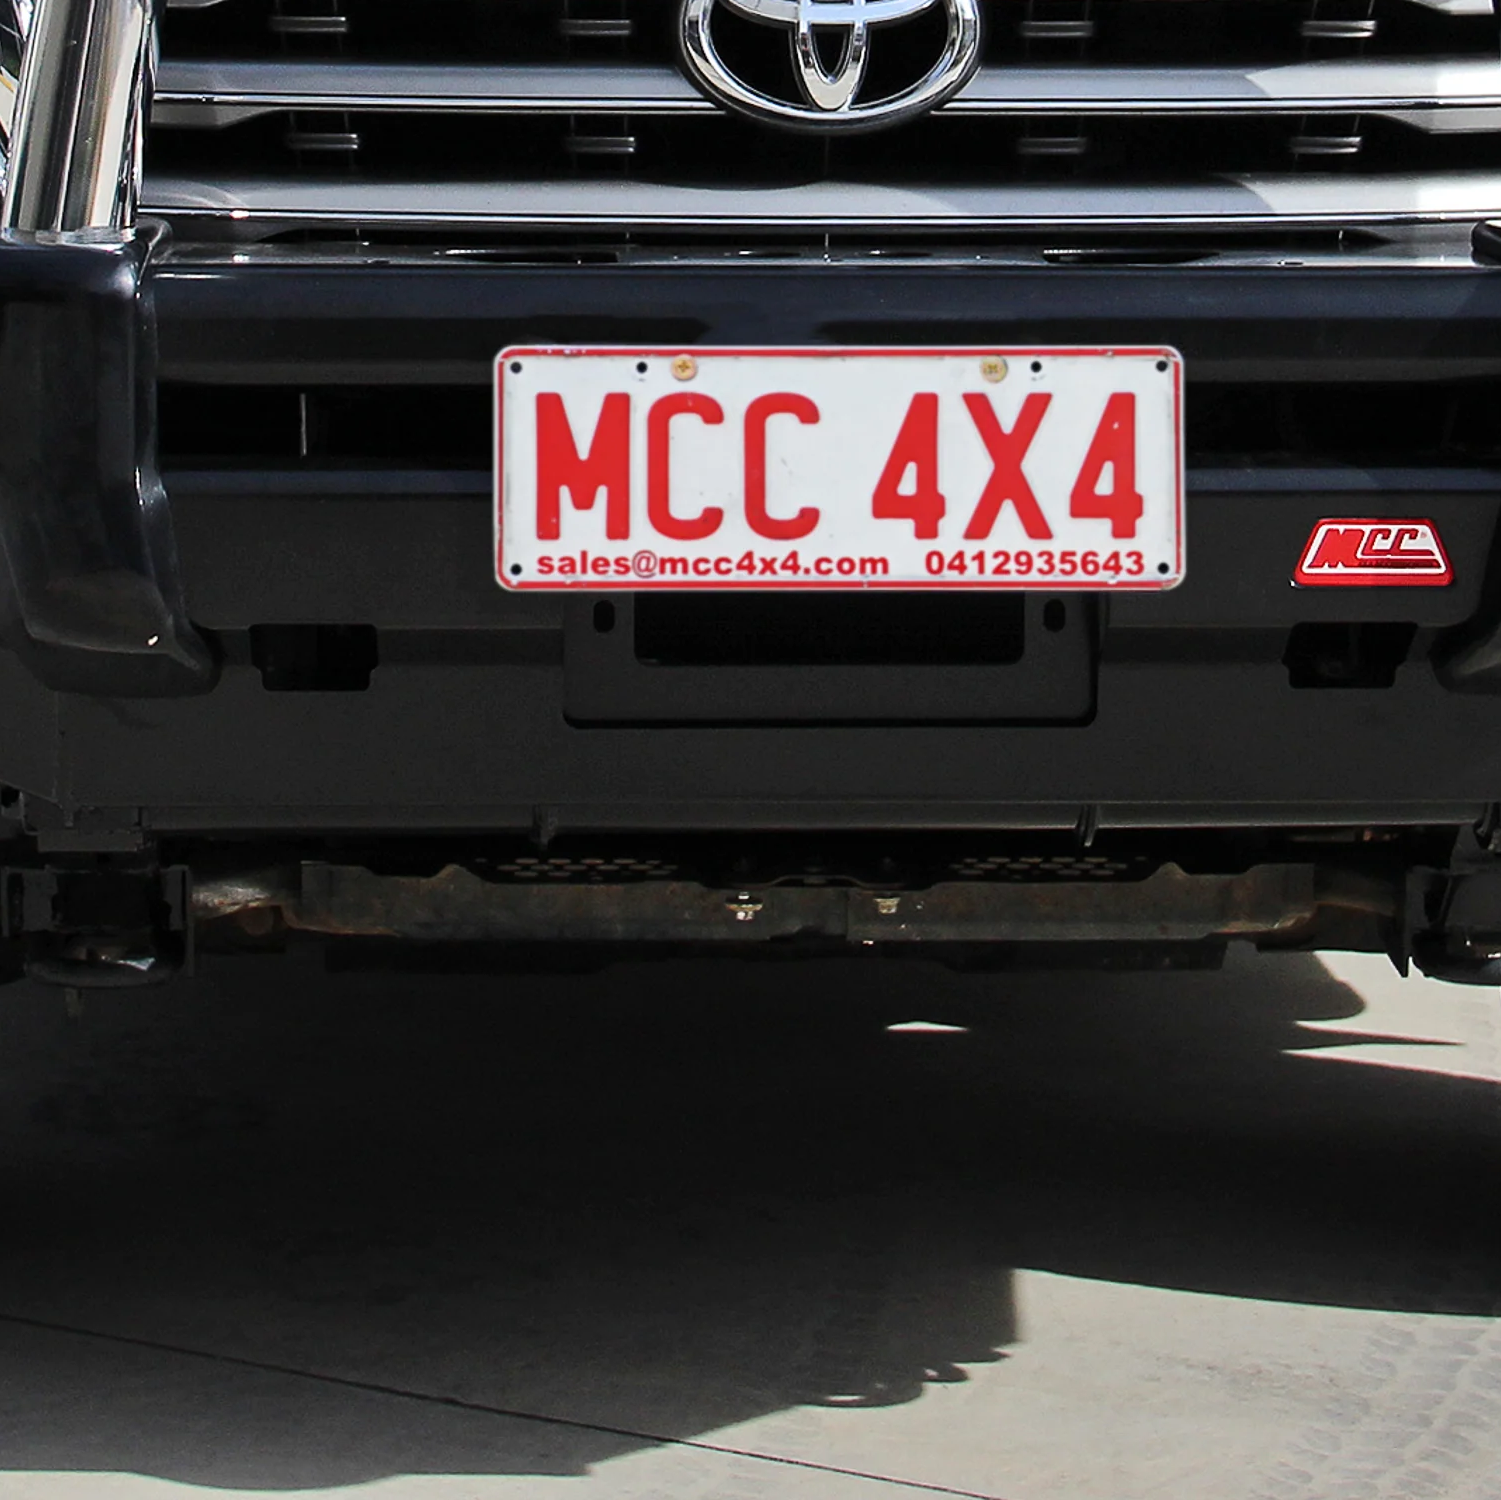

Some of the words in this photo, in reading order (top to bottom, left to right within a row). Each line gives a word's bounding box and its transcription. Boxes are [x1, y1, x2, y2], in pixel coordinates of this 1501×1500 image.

[535, 391, 821, 542] MCC
[871, 391, 1145, 541] 4X4
[536, 549, 890, 577] sales@mcc4x4.com
[924, 549, 1146, 577] 0412935643
[1308, 528, 1435, 568] MCC
